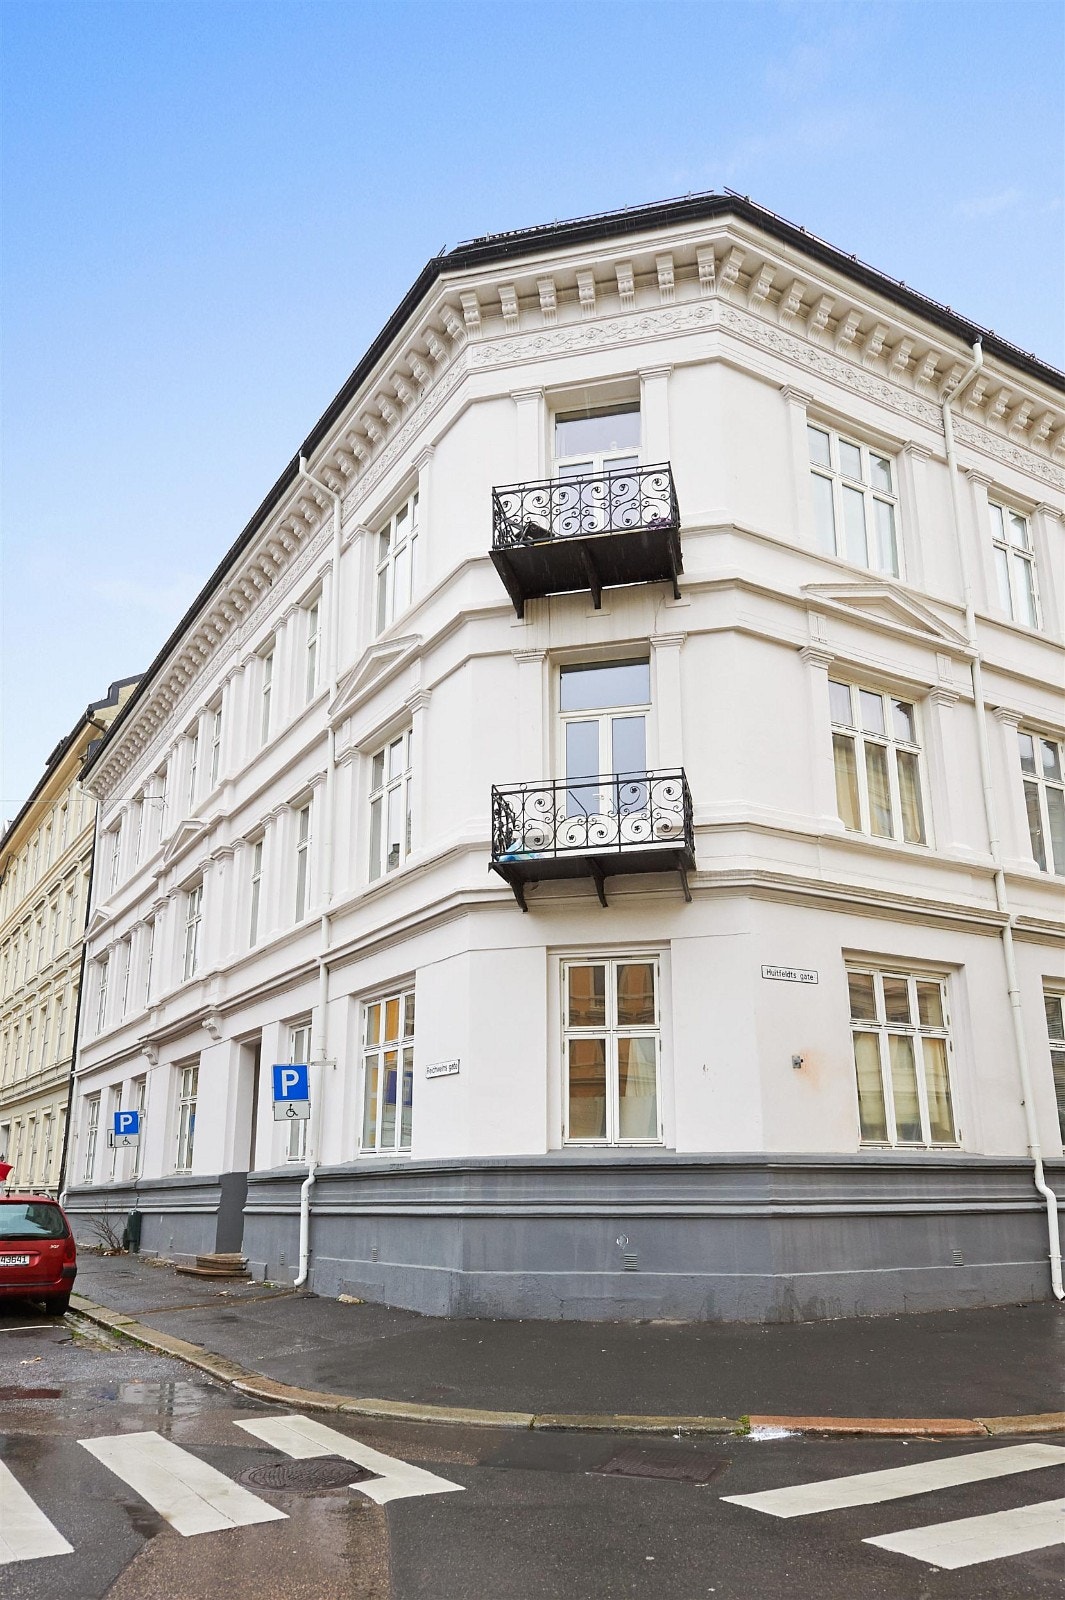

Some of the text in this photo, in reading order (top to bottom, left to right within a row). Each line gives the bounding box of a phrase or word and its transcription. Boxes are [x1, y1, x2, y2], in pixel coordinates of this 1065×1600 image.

[766, 968, 814, 982] Huitfeldts gate
[281, 1069, 300, 1097] P
[120, 1114, 133, 1133] P
